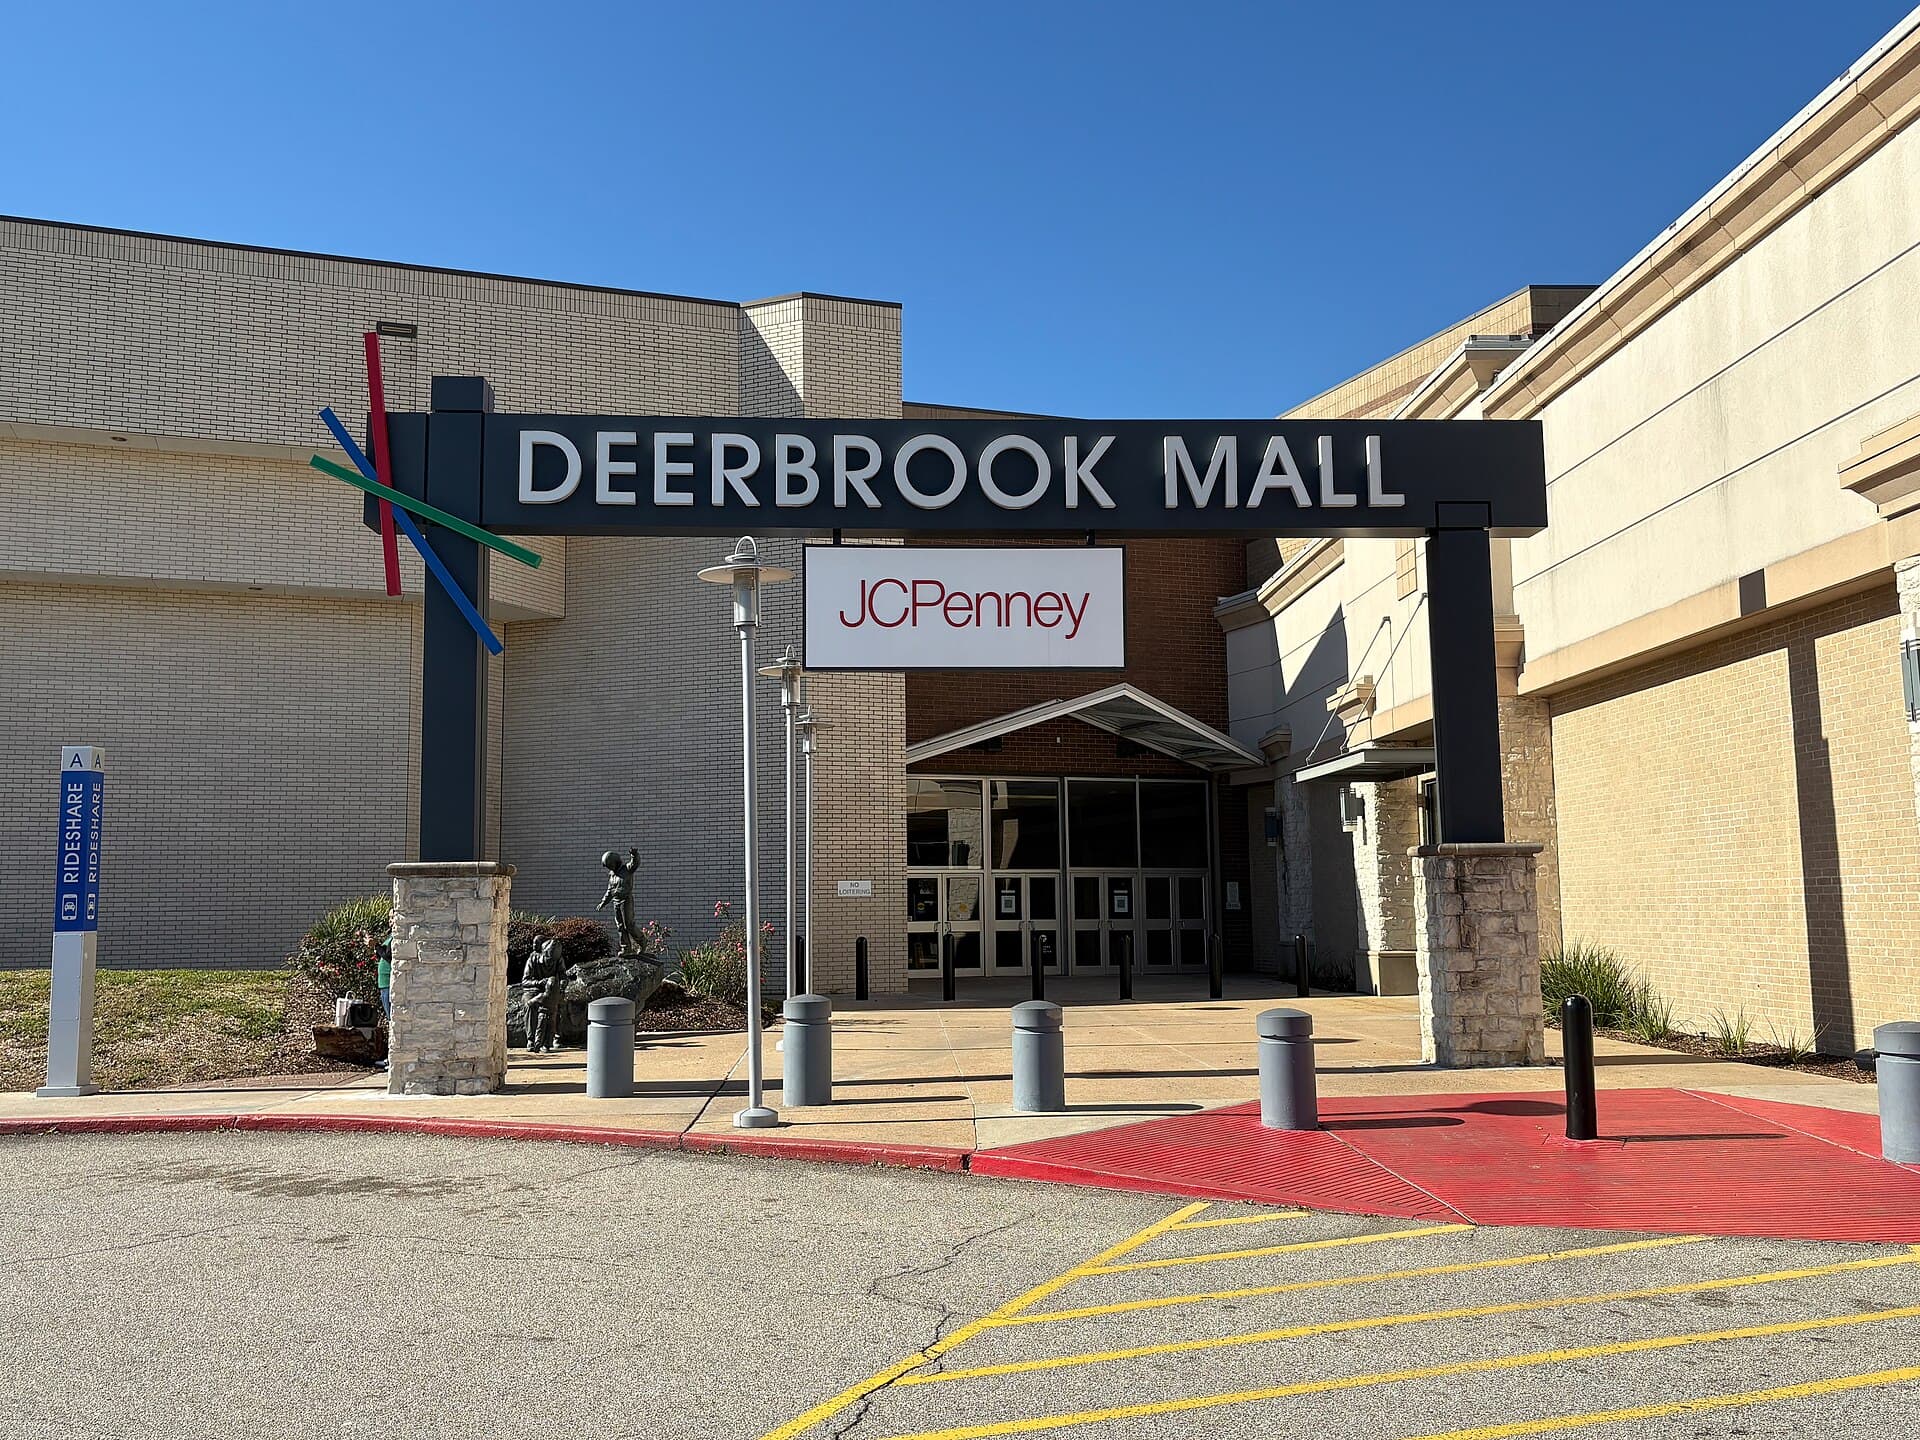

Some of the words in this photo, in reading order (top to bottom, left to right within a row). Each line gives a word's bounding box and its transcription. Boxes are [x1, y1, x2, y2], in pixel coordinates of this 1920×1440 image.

[518, 430, 1117, 509] DEERBROOK
[1163, 434, 1405, 508] MALL
[839, 578, 1091, 640] JCPenney
[70, 753, 83, 768] A
[94, 753, 102, 768] A
[63, 783, 83, 883] RIDESHARE
[88, 783, 101, 883] RIDESHARE
